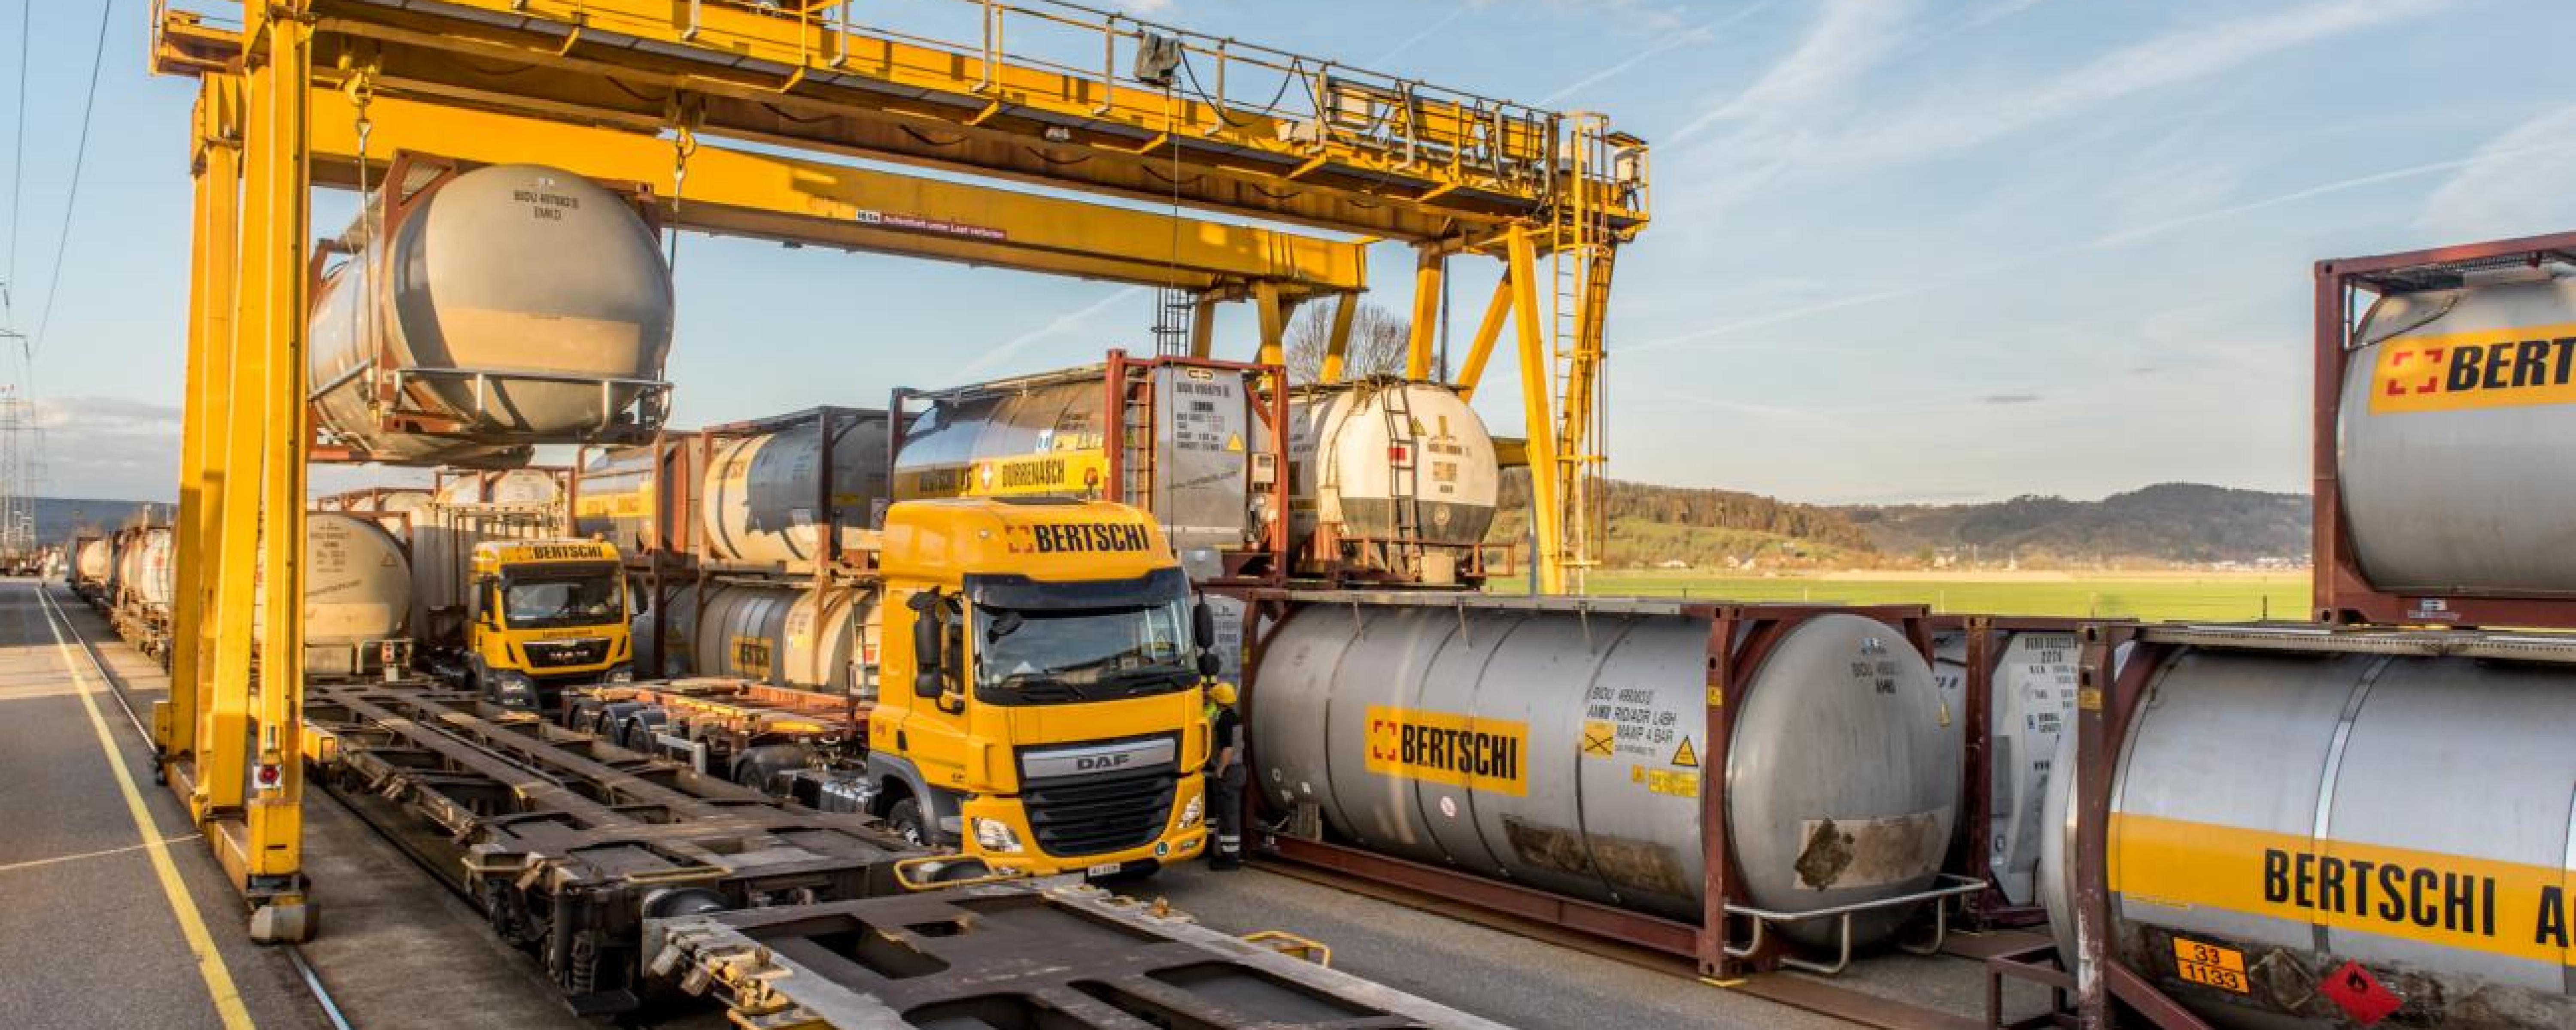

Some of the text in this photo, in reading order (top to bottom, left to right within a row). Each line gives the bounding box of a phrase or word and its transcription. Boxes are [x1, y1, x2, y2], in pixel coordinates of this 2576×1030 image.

[2447, 337, 2576, 392] BERT
[1035, 523, 1150, 554] BERTSCHI
[534, 546, 603, 560] BERTSCHI
[1654, 728, 1674, 745] BAR
[1077, 754, 1129, 771] DAF
[1401, 723, 1518, 781] BERTSCHI
[2264, 849, 2576, 948] BERTSCHI A
[2193, 944, 2221, 963] 33
[2185, 963, 2239, 989] 1133
